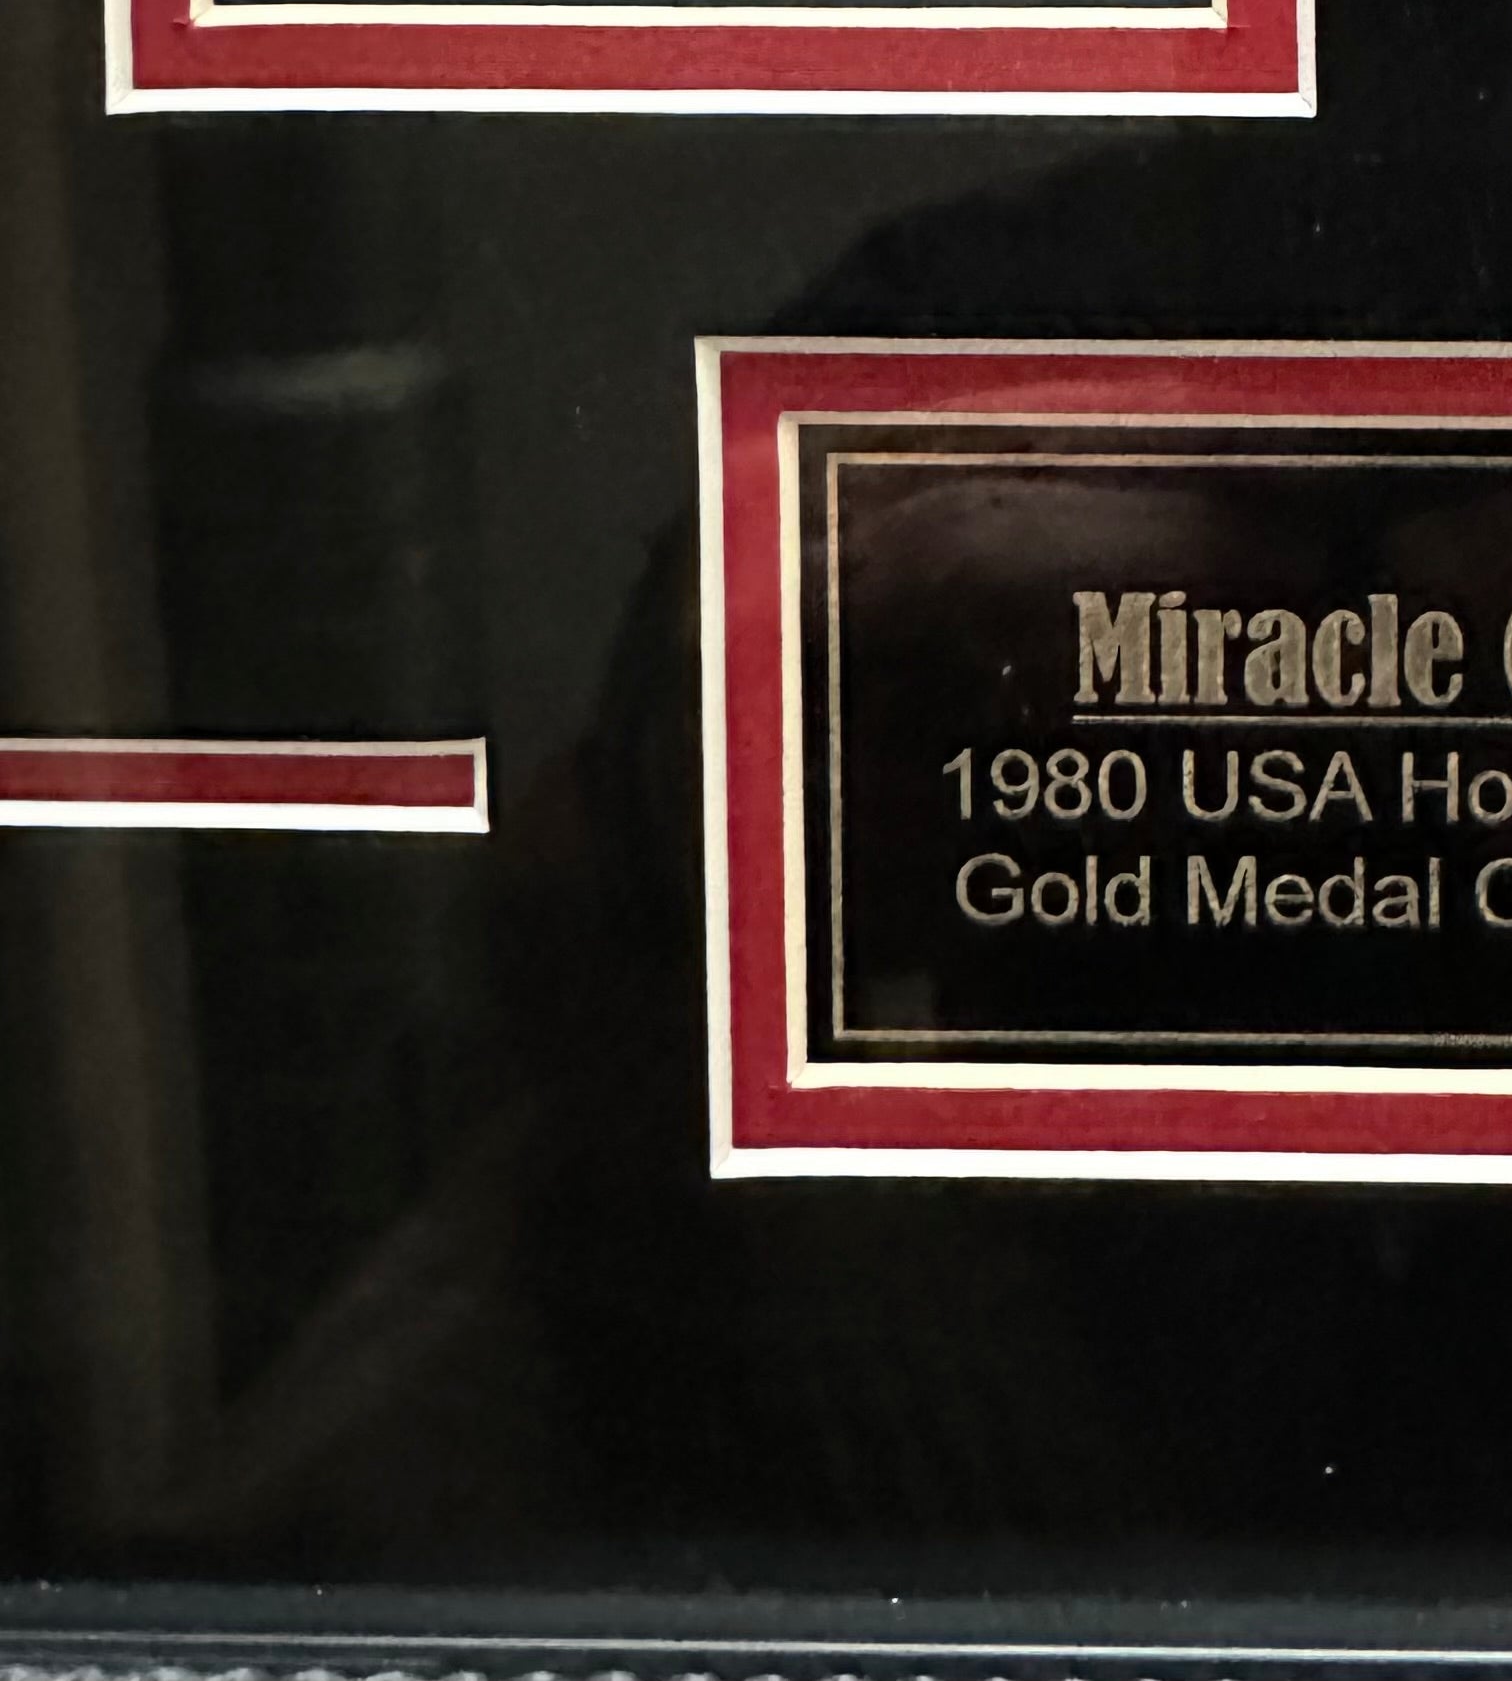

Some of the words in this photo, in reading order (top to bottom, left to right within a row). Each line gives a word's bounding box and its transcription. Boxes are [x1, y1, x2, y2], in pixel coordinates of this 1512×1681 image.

[1072, 590, 1465, 708] Miracle
[943, 747, 1148, 821] 1980
[1183, 749, 1373, 822] USA
[955, 852, 1151, 926] Gold
[1188, 856, 1442, 928] Medal
